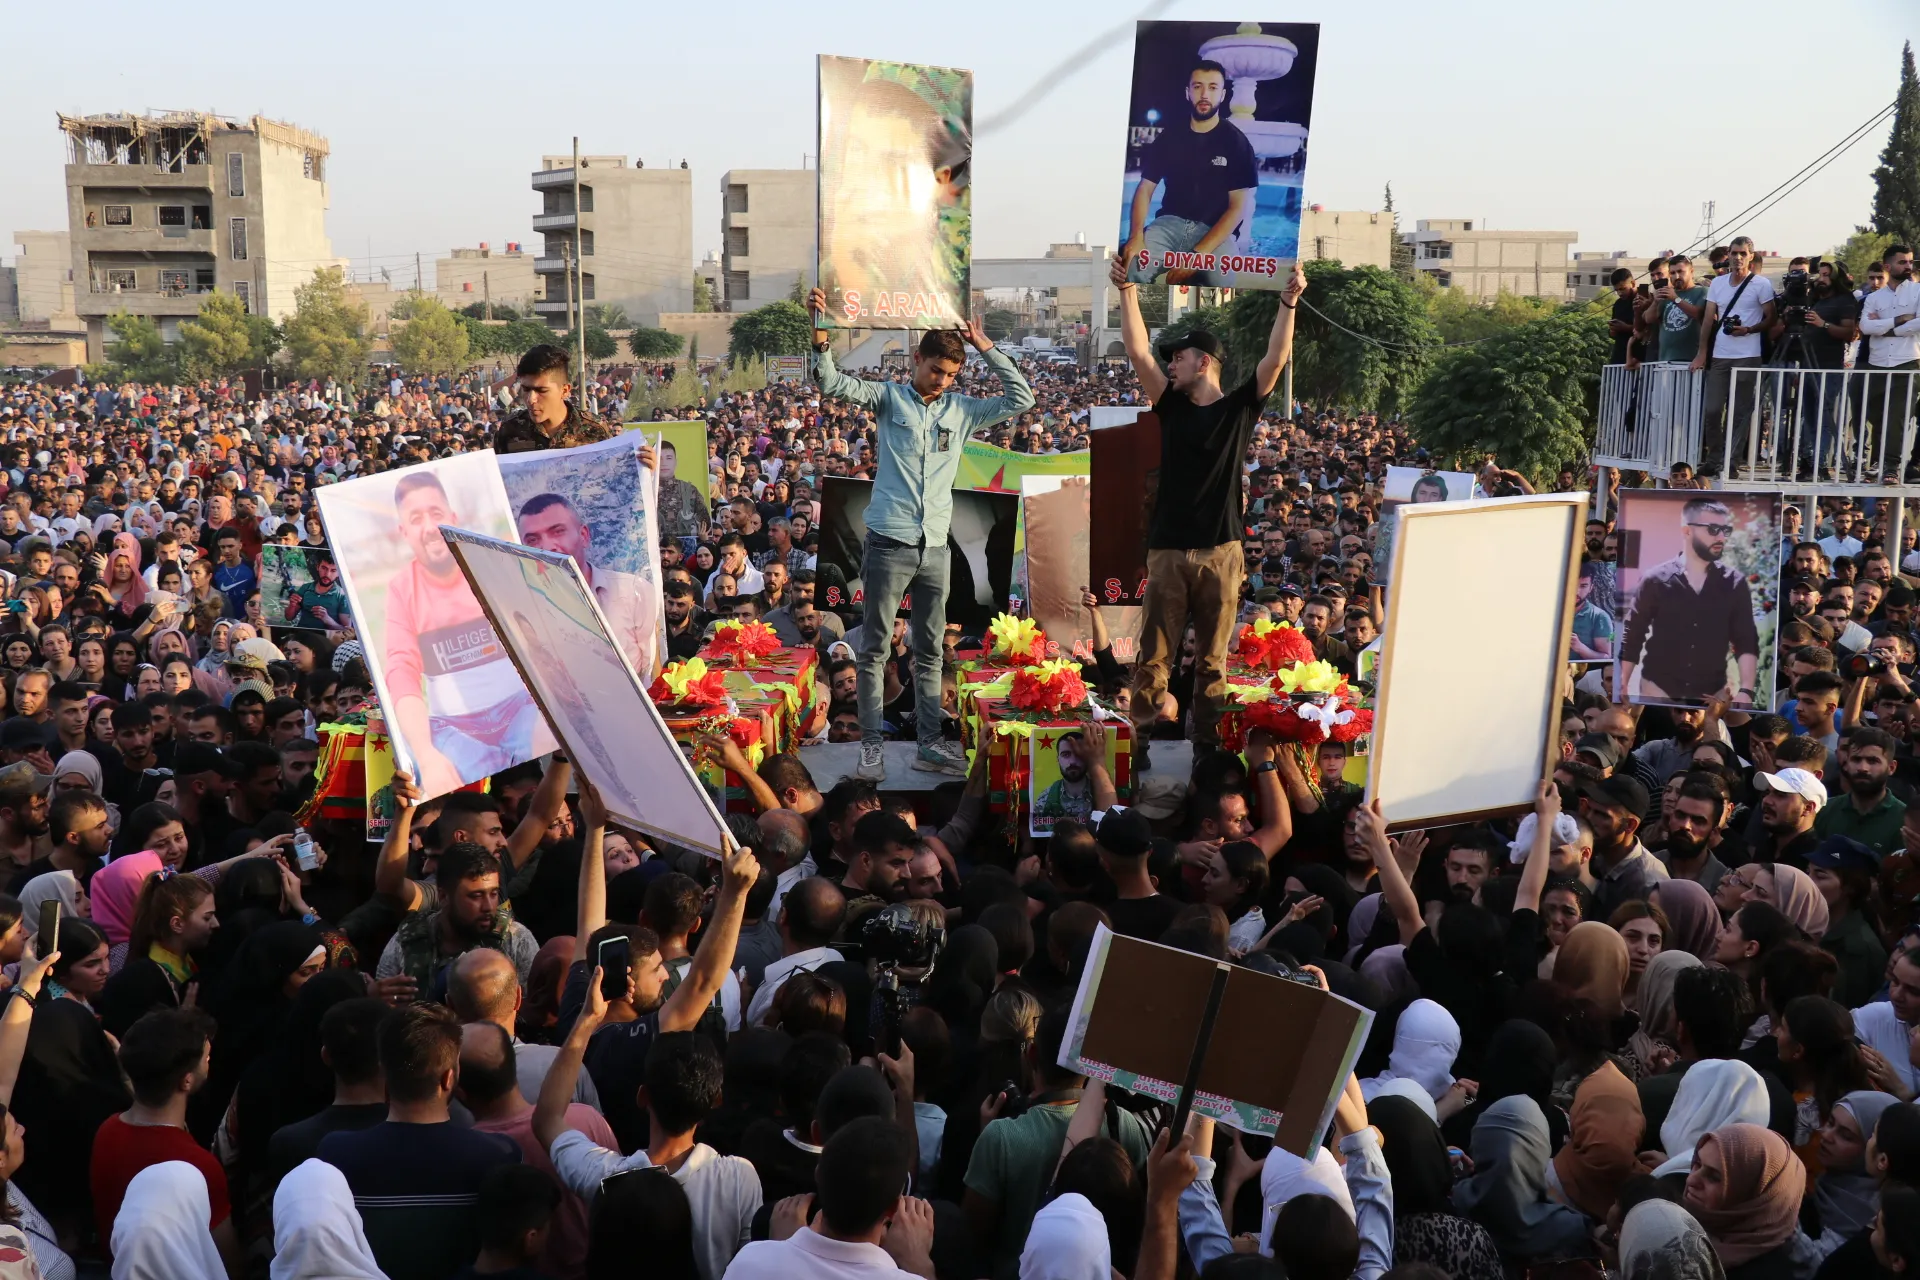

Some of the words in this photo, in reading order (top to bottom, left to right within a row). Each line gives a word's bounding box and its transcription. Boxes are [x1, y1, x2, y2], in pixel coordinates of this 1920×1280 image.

[1163, 251, 1215, 271] DIYAR
[1219, 255, 1277, 278] ŞOREŞ
[843, 290, 868, 322] Ş.
[850, 589, 912, 611] AM
[1104, 577, 1129, 604] Ş.
[1071, 636, 1134, 660] AM
